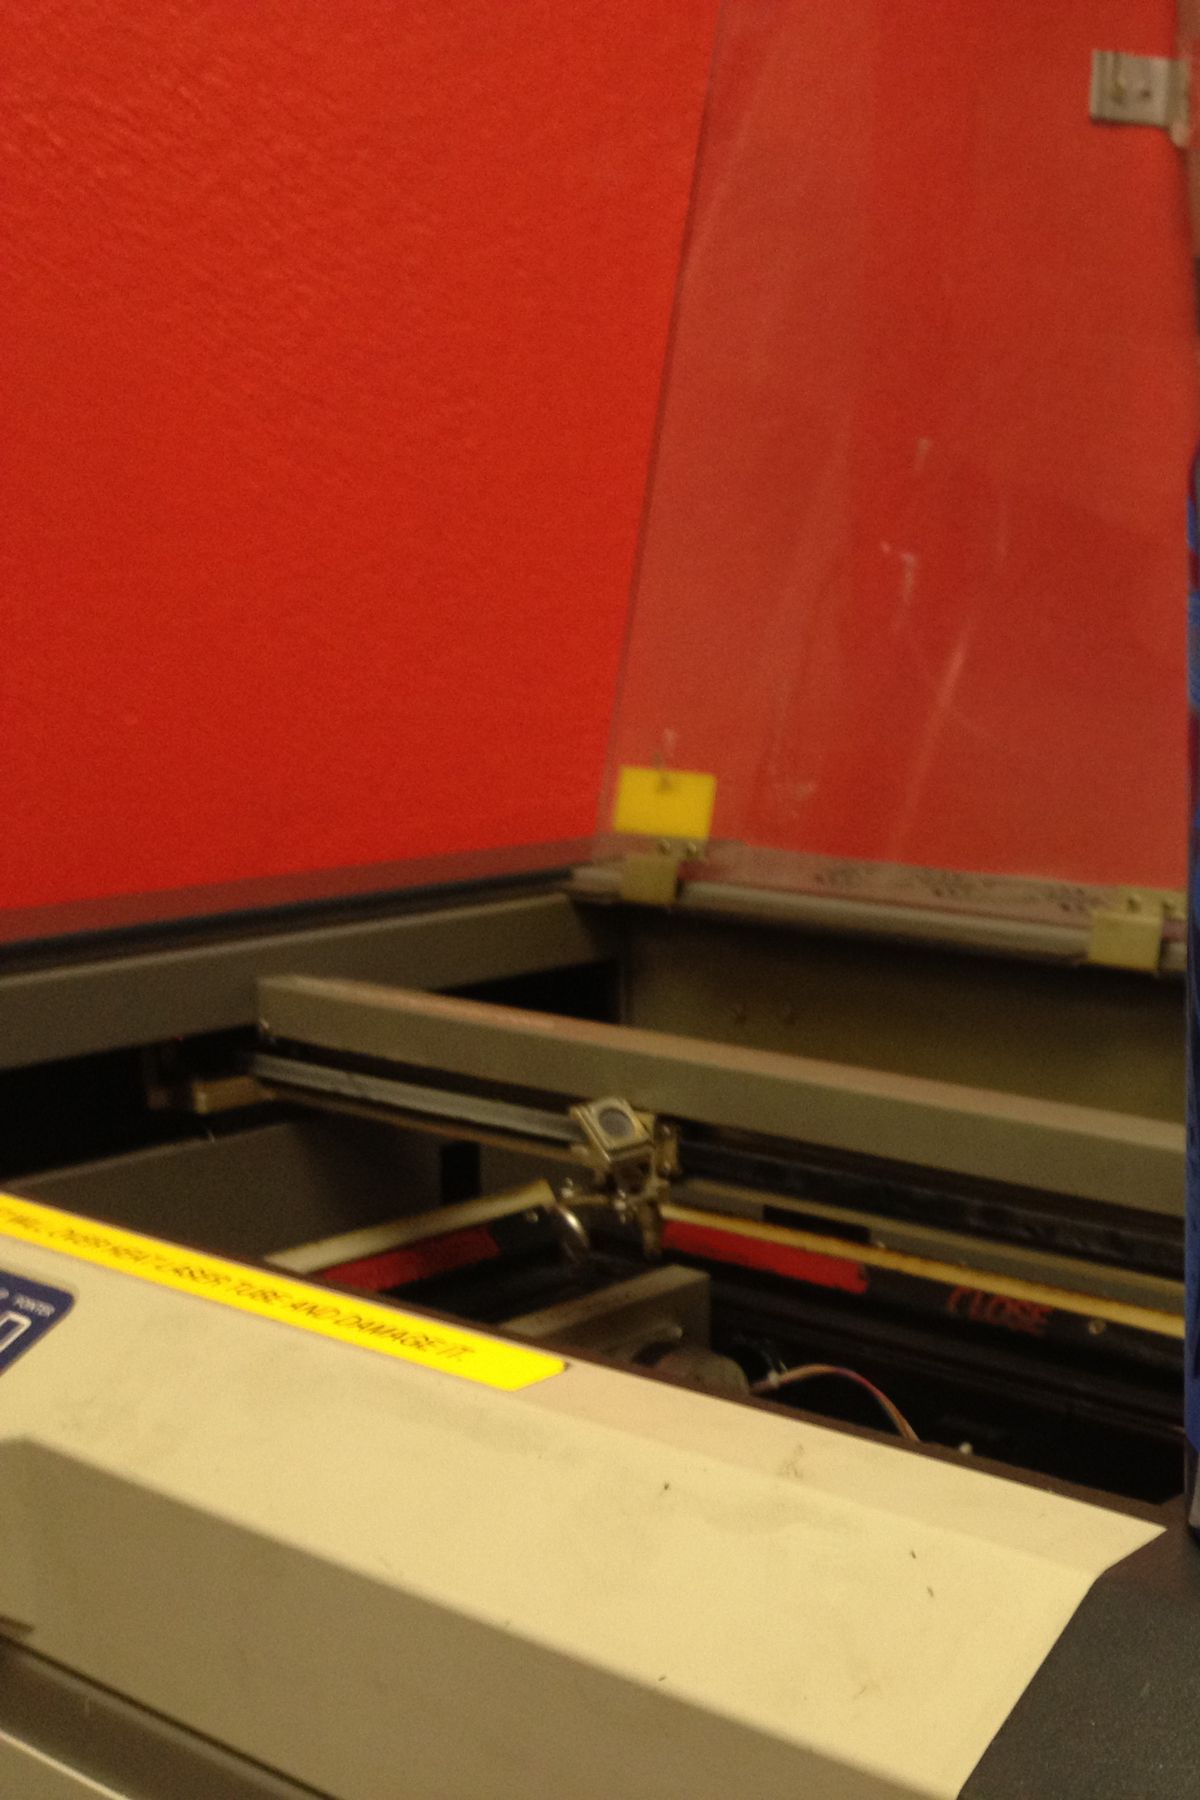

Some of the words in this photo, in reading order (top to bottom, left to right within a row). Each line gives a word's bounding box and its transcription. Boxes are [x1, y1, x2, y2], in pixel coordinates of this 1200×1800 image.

[228, 1281, 292, 1305] TUBE
[290, 1301, 340, 1319] AND
[334, 1314, 444, 1352] DAMAGE
